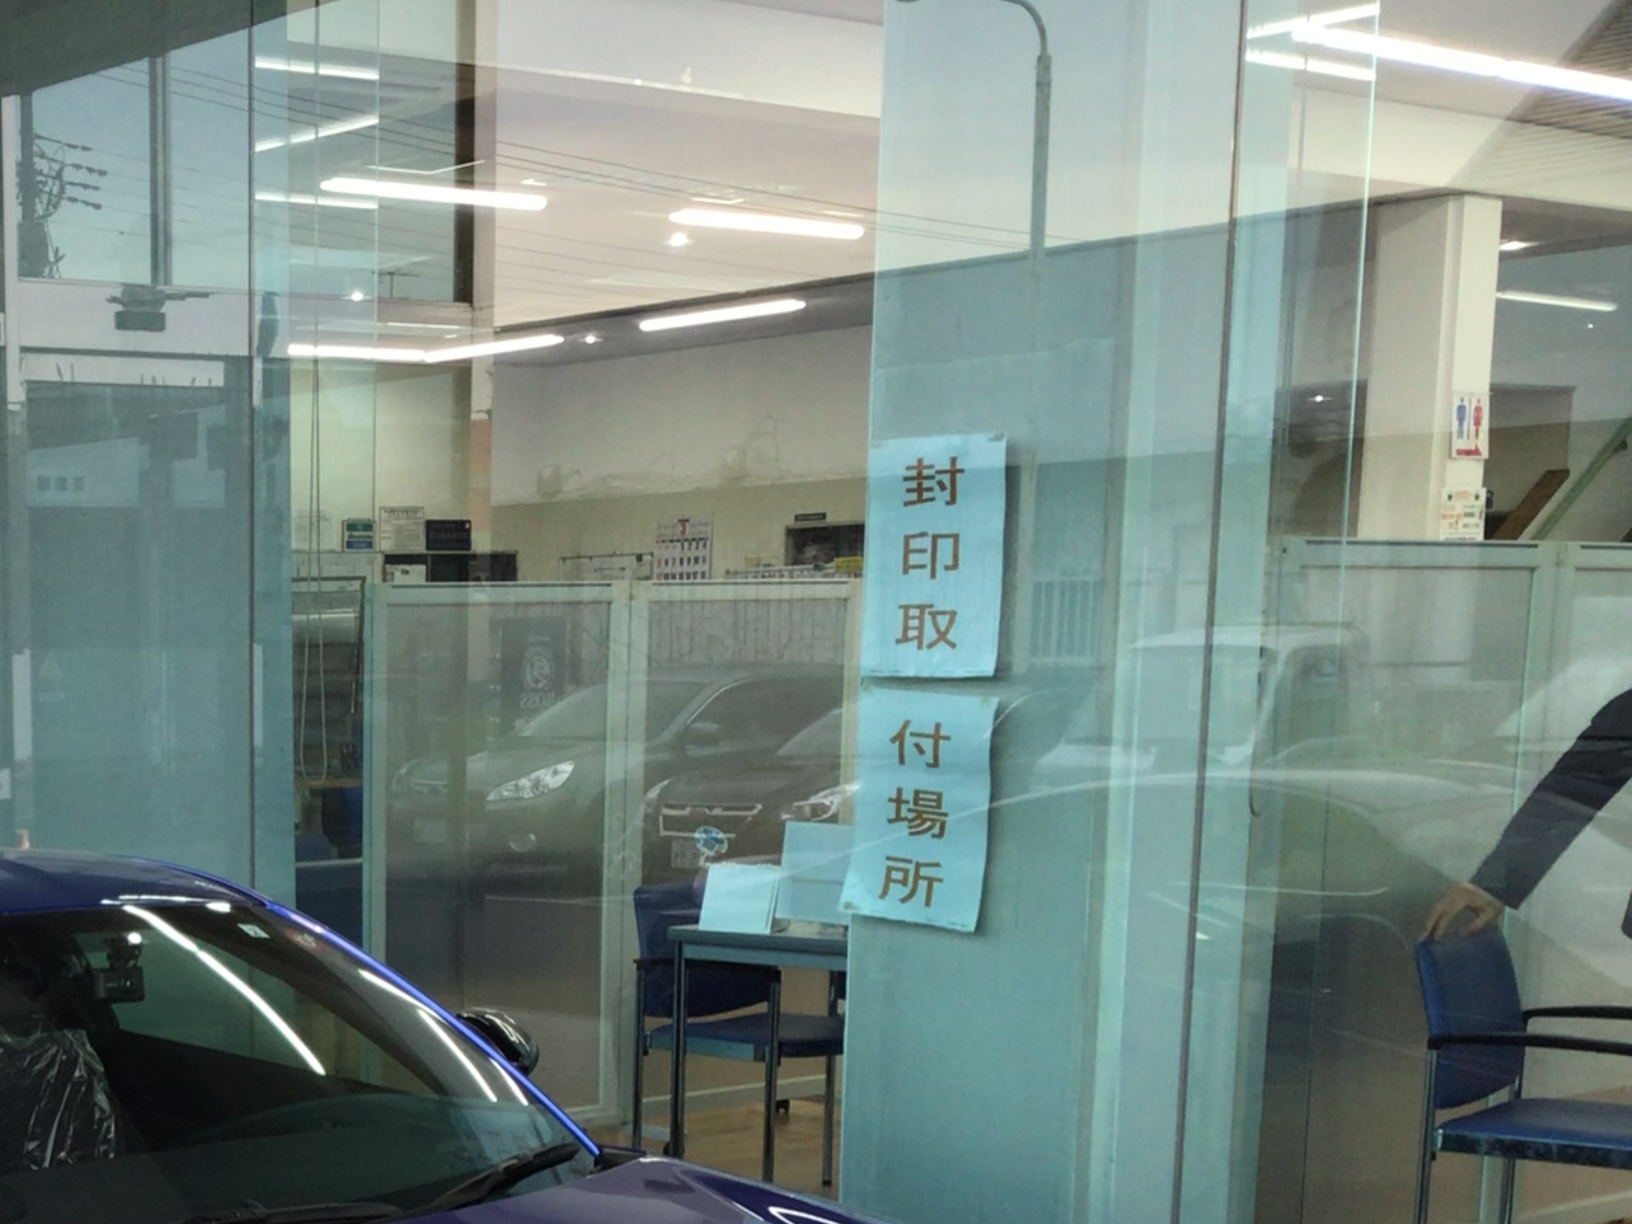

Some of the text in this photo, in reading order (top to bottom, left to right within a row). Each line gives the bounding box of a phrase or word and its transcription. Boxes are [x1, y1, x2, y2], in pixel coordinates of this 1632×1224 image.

[895, 455, 966, 651] 封印取
[879, 719, 952, 909] 付場所
